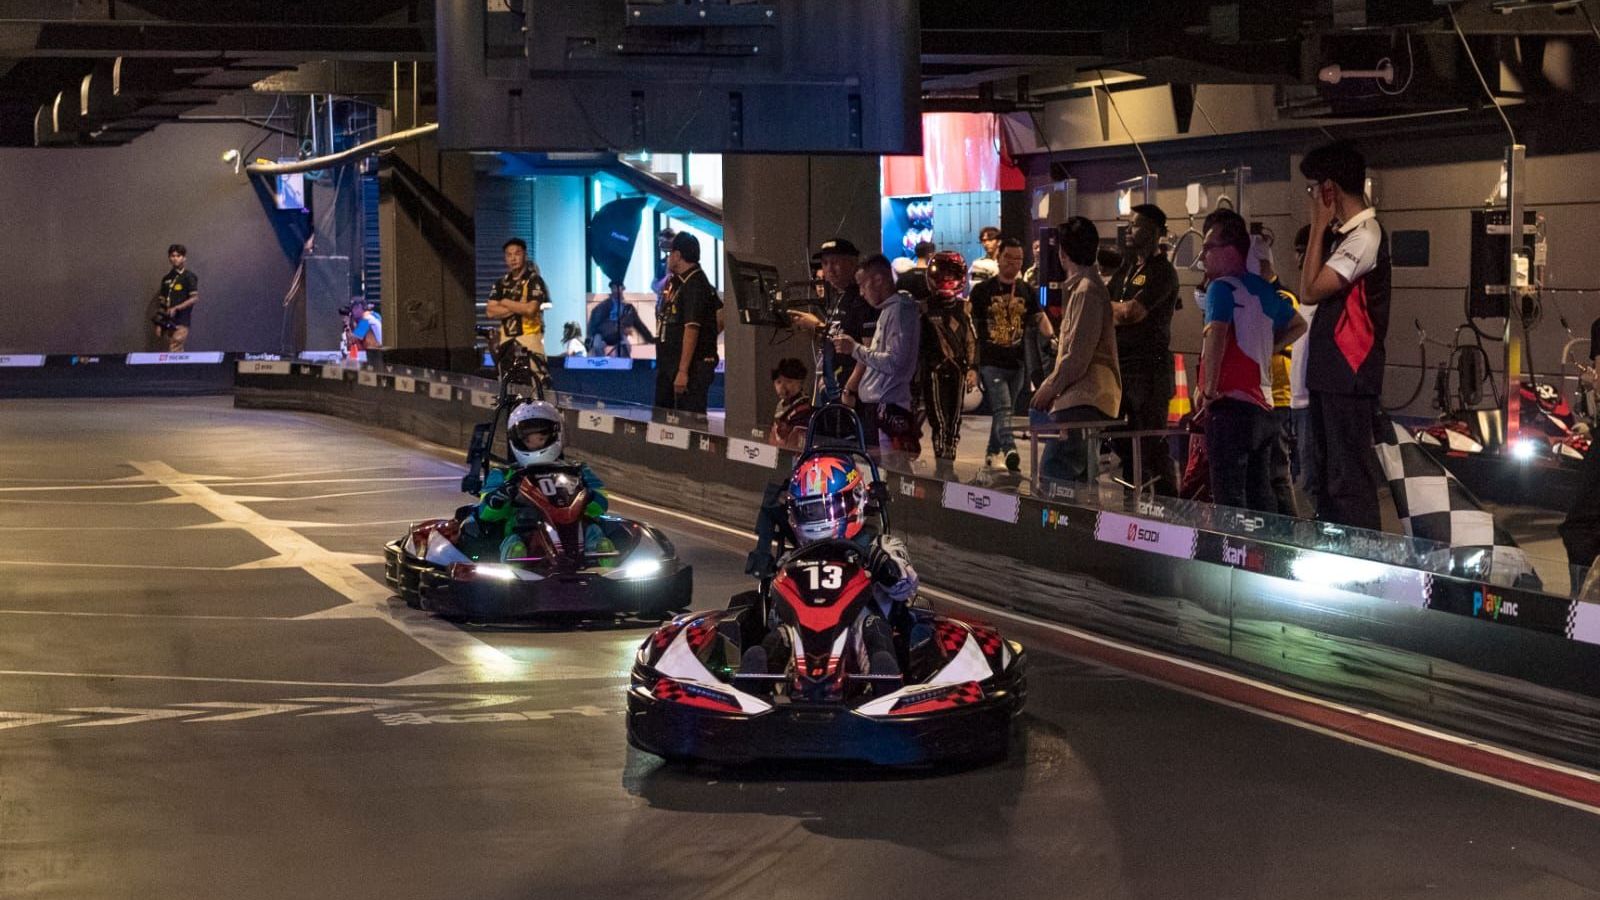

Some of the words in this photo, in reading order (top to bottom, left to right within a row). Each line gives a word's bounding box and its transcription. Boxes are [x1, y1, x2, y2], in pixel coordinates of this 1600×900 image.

[1138, 528, 1160, 543] SODI
[803, 565, 843, 590] 13
[1473, 583, 1519, 620] play.inc
